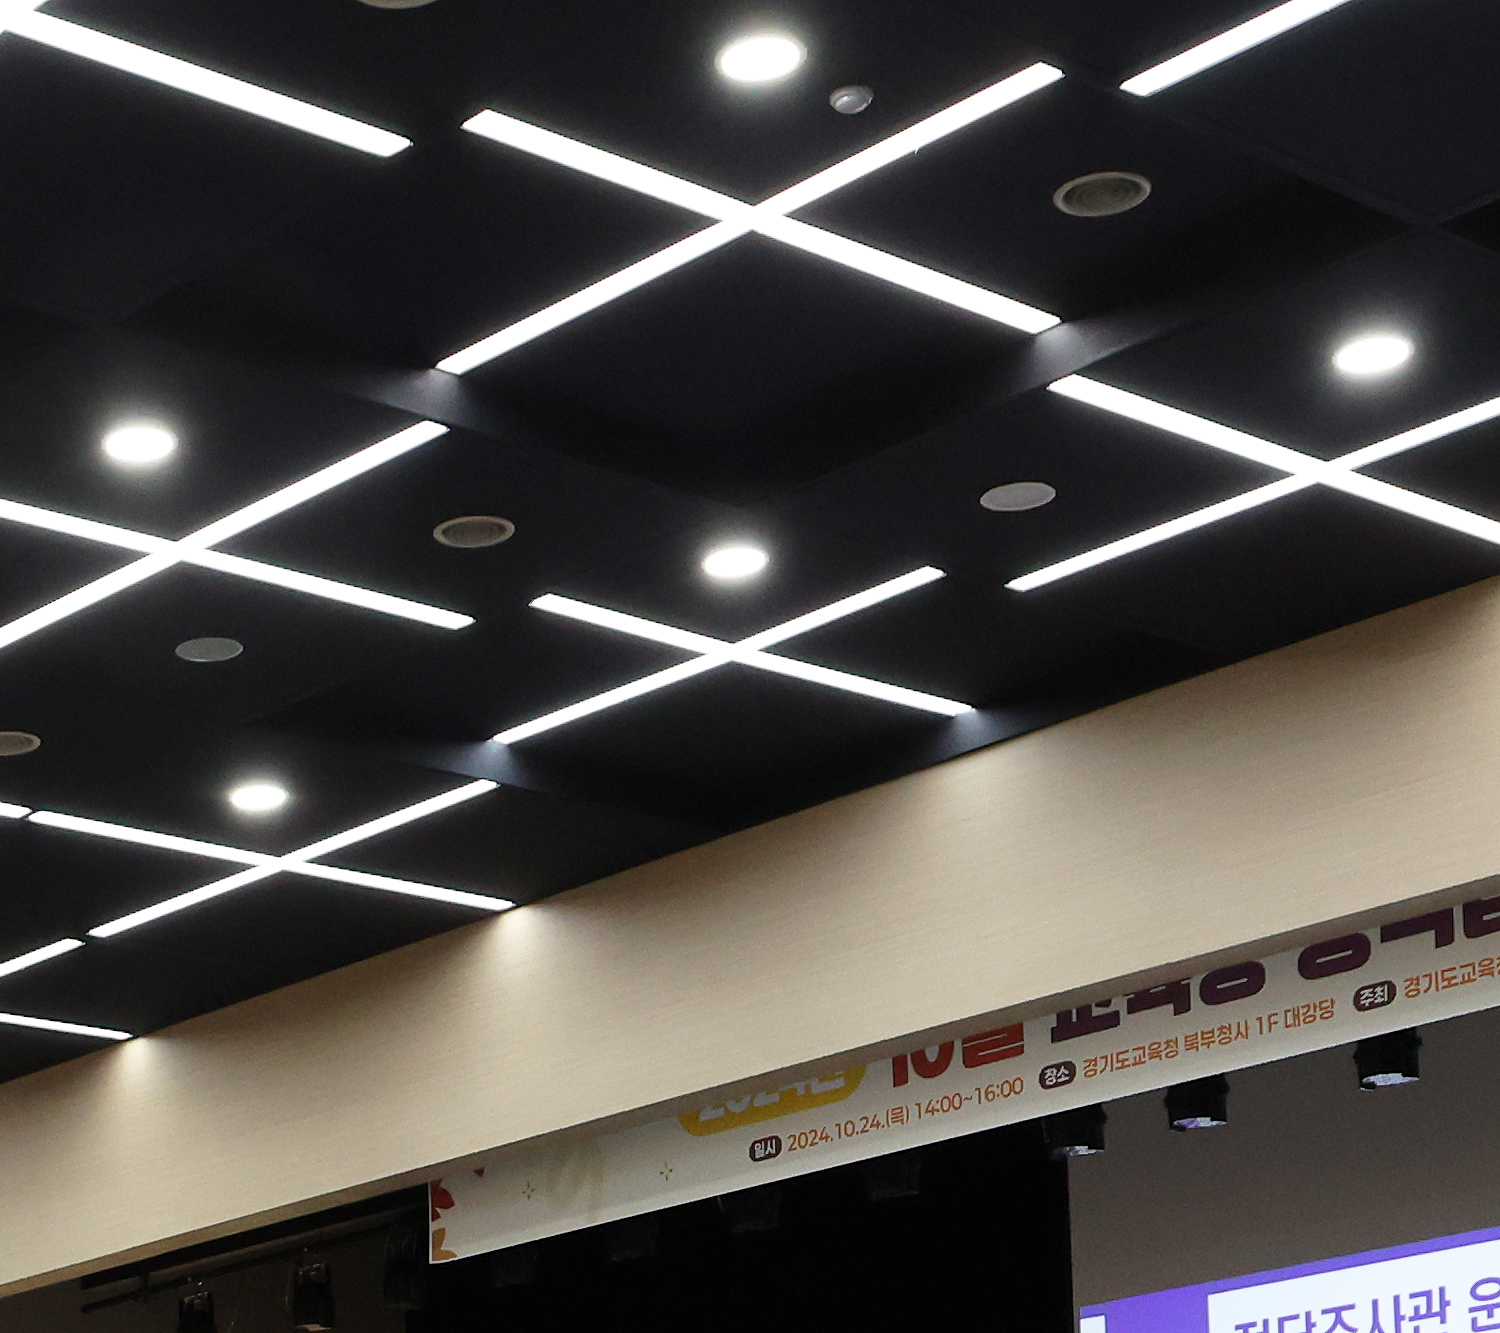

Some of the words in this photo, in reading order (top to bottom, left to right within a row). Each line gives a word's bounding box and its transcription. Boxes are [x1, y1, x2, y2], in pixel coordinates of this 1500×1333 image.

[1083, 1036, 1179, 1078] 경기도교육청
[1184, 1020, 1250, 1052] 북부청사
[1256, 1013, 1278, 1036] 1F
[1284, 998, 1336, 1029] 대강당
[787, 1105, 910, 1152] 2024.10.24.(목)
[915, 1077, 1024, 1120] 14:00~16:00
